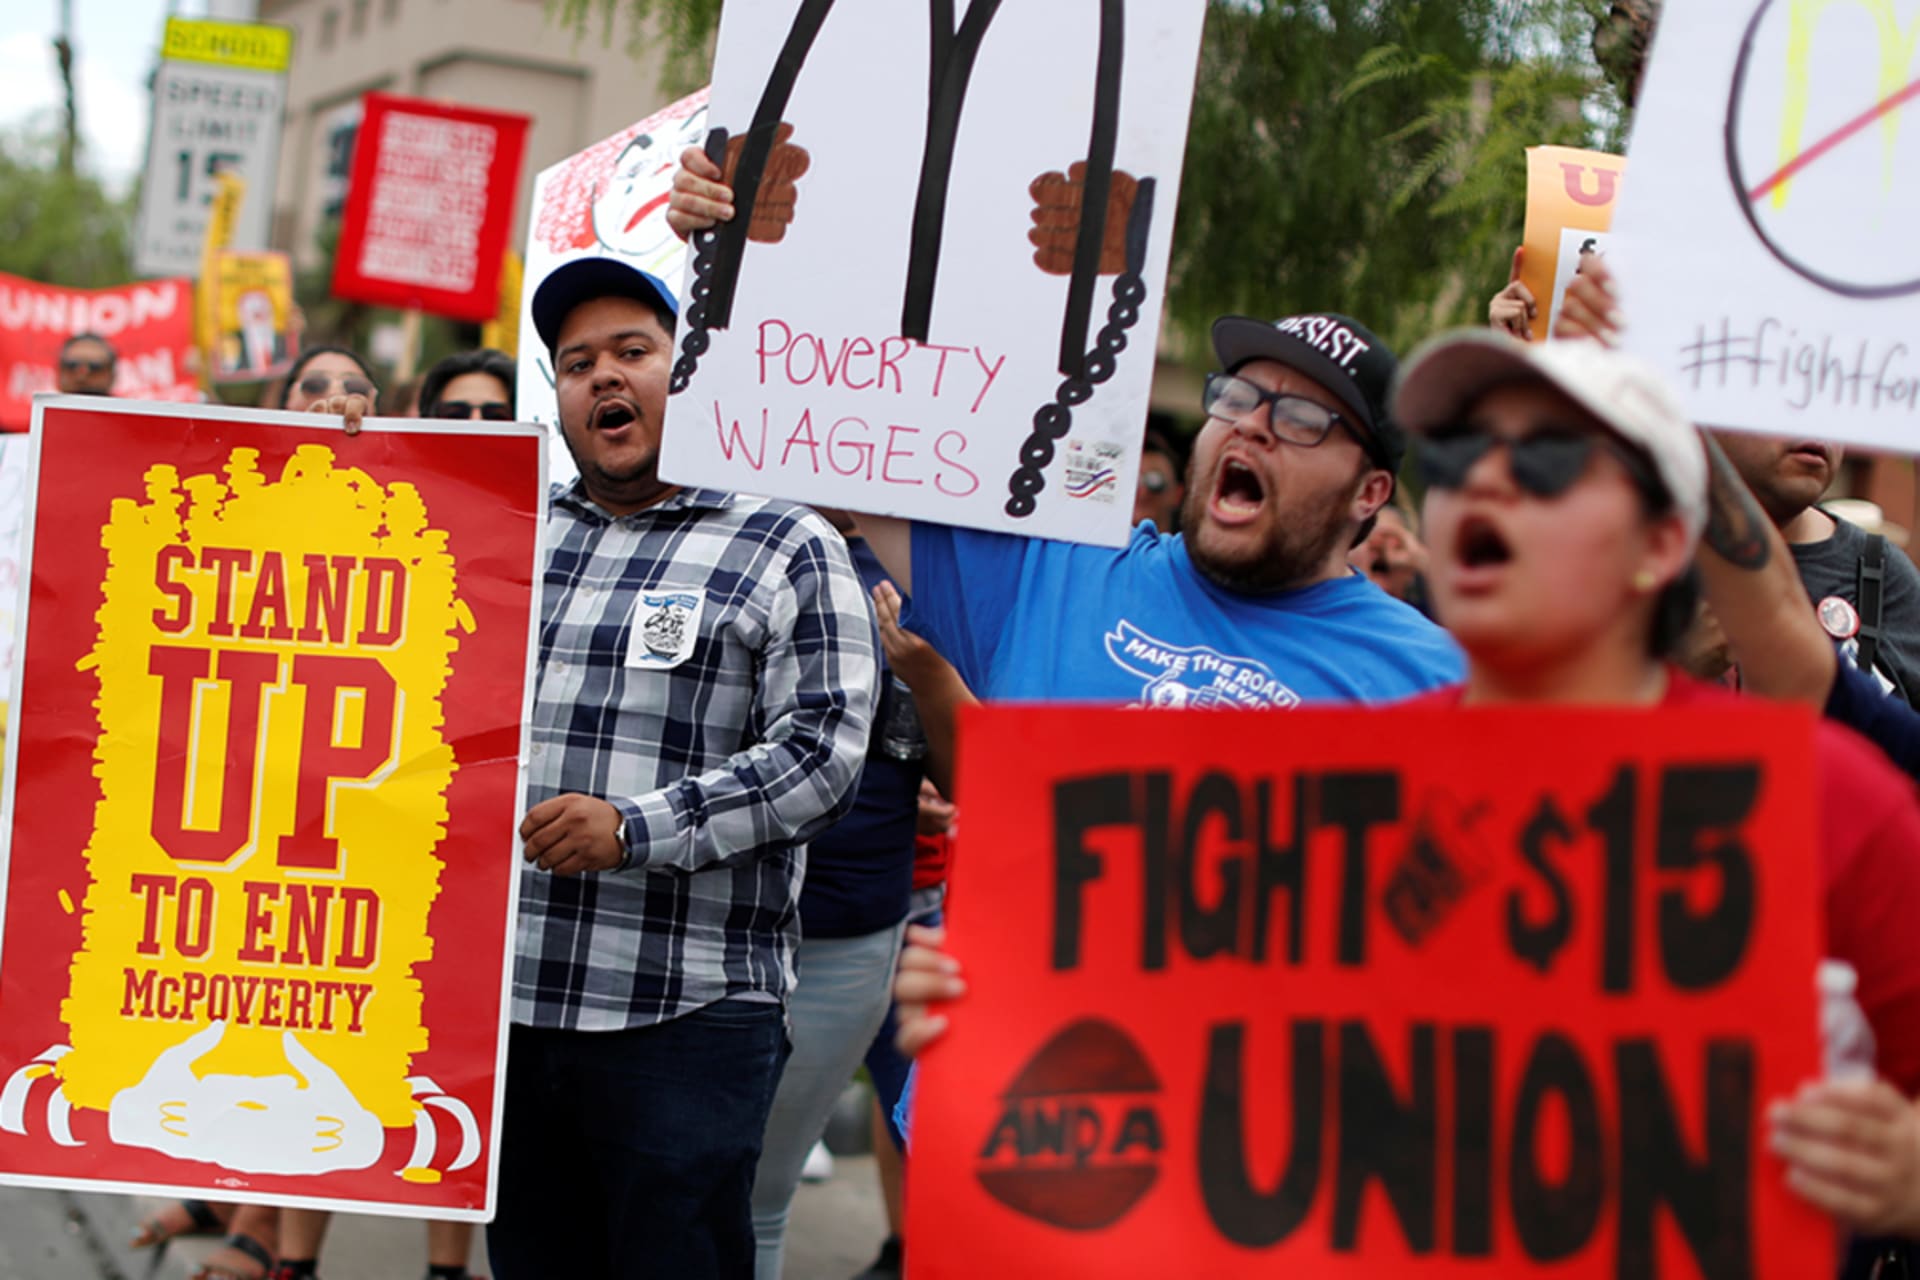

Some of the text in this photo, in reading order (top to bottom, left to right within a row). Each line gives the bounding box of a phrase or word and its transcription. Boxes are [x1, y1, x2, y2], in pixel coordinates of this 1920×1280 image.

[0, 281, 178, 336] UNION
[713, 399, 981, 498] WAGES
[151, 543, 409, 650] STAND
[1124, 638, 1292, 707] MAKE THE ROAD
[147, 644, 405, 878] UP
[131, 872, 384, 973] TO END
[1050, 766, 1402, 972] FIGHT
[1503, 756, 1764, 996] $15
[980, 1103, 1103, 1171] AND
[1198, 1017, 1758, 1280] UNION
